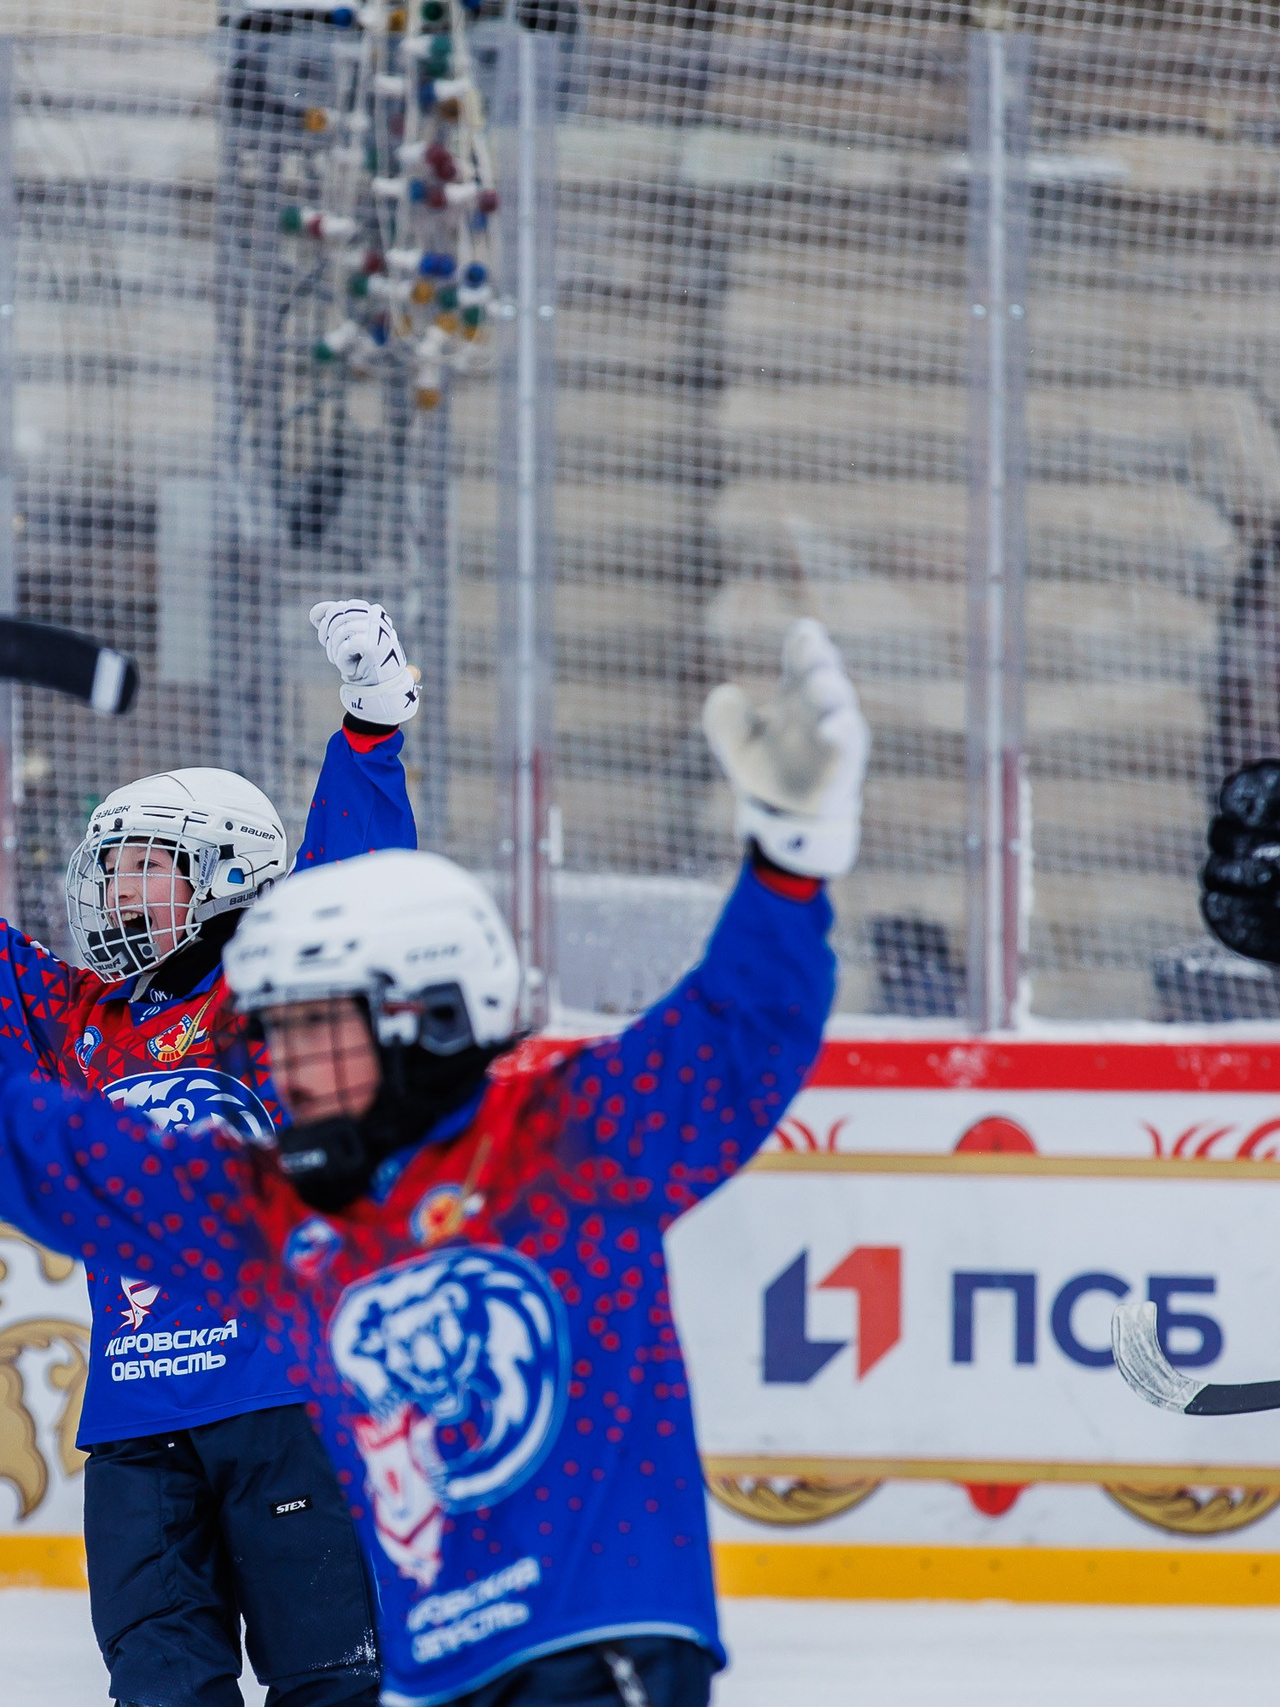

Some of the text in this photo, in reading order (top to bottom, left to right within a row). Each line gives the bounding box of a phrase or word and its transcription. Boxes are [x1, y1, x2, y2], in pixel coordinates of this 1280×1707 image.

[94, 804, 131, 821] BAUER
[240, 825, 276, 842] BAUER
[96, 957, 122, 972] AUER
[951, 1270, 1225, 1368] ПСБ
[110, 1350, 227, 1382] ОБЛАСТЬ
[276, 1499, 307, 1514] STEX
